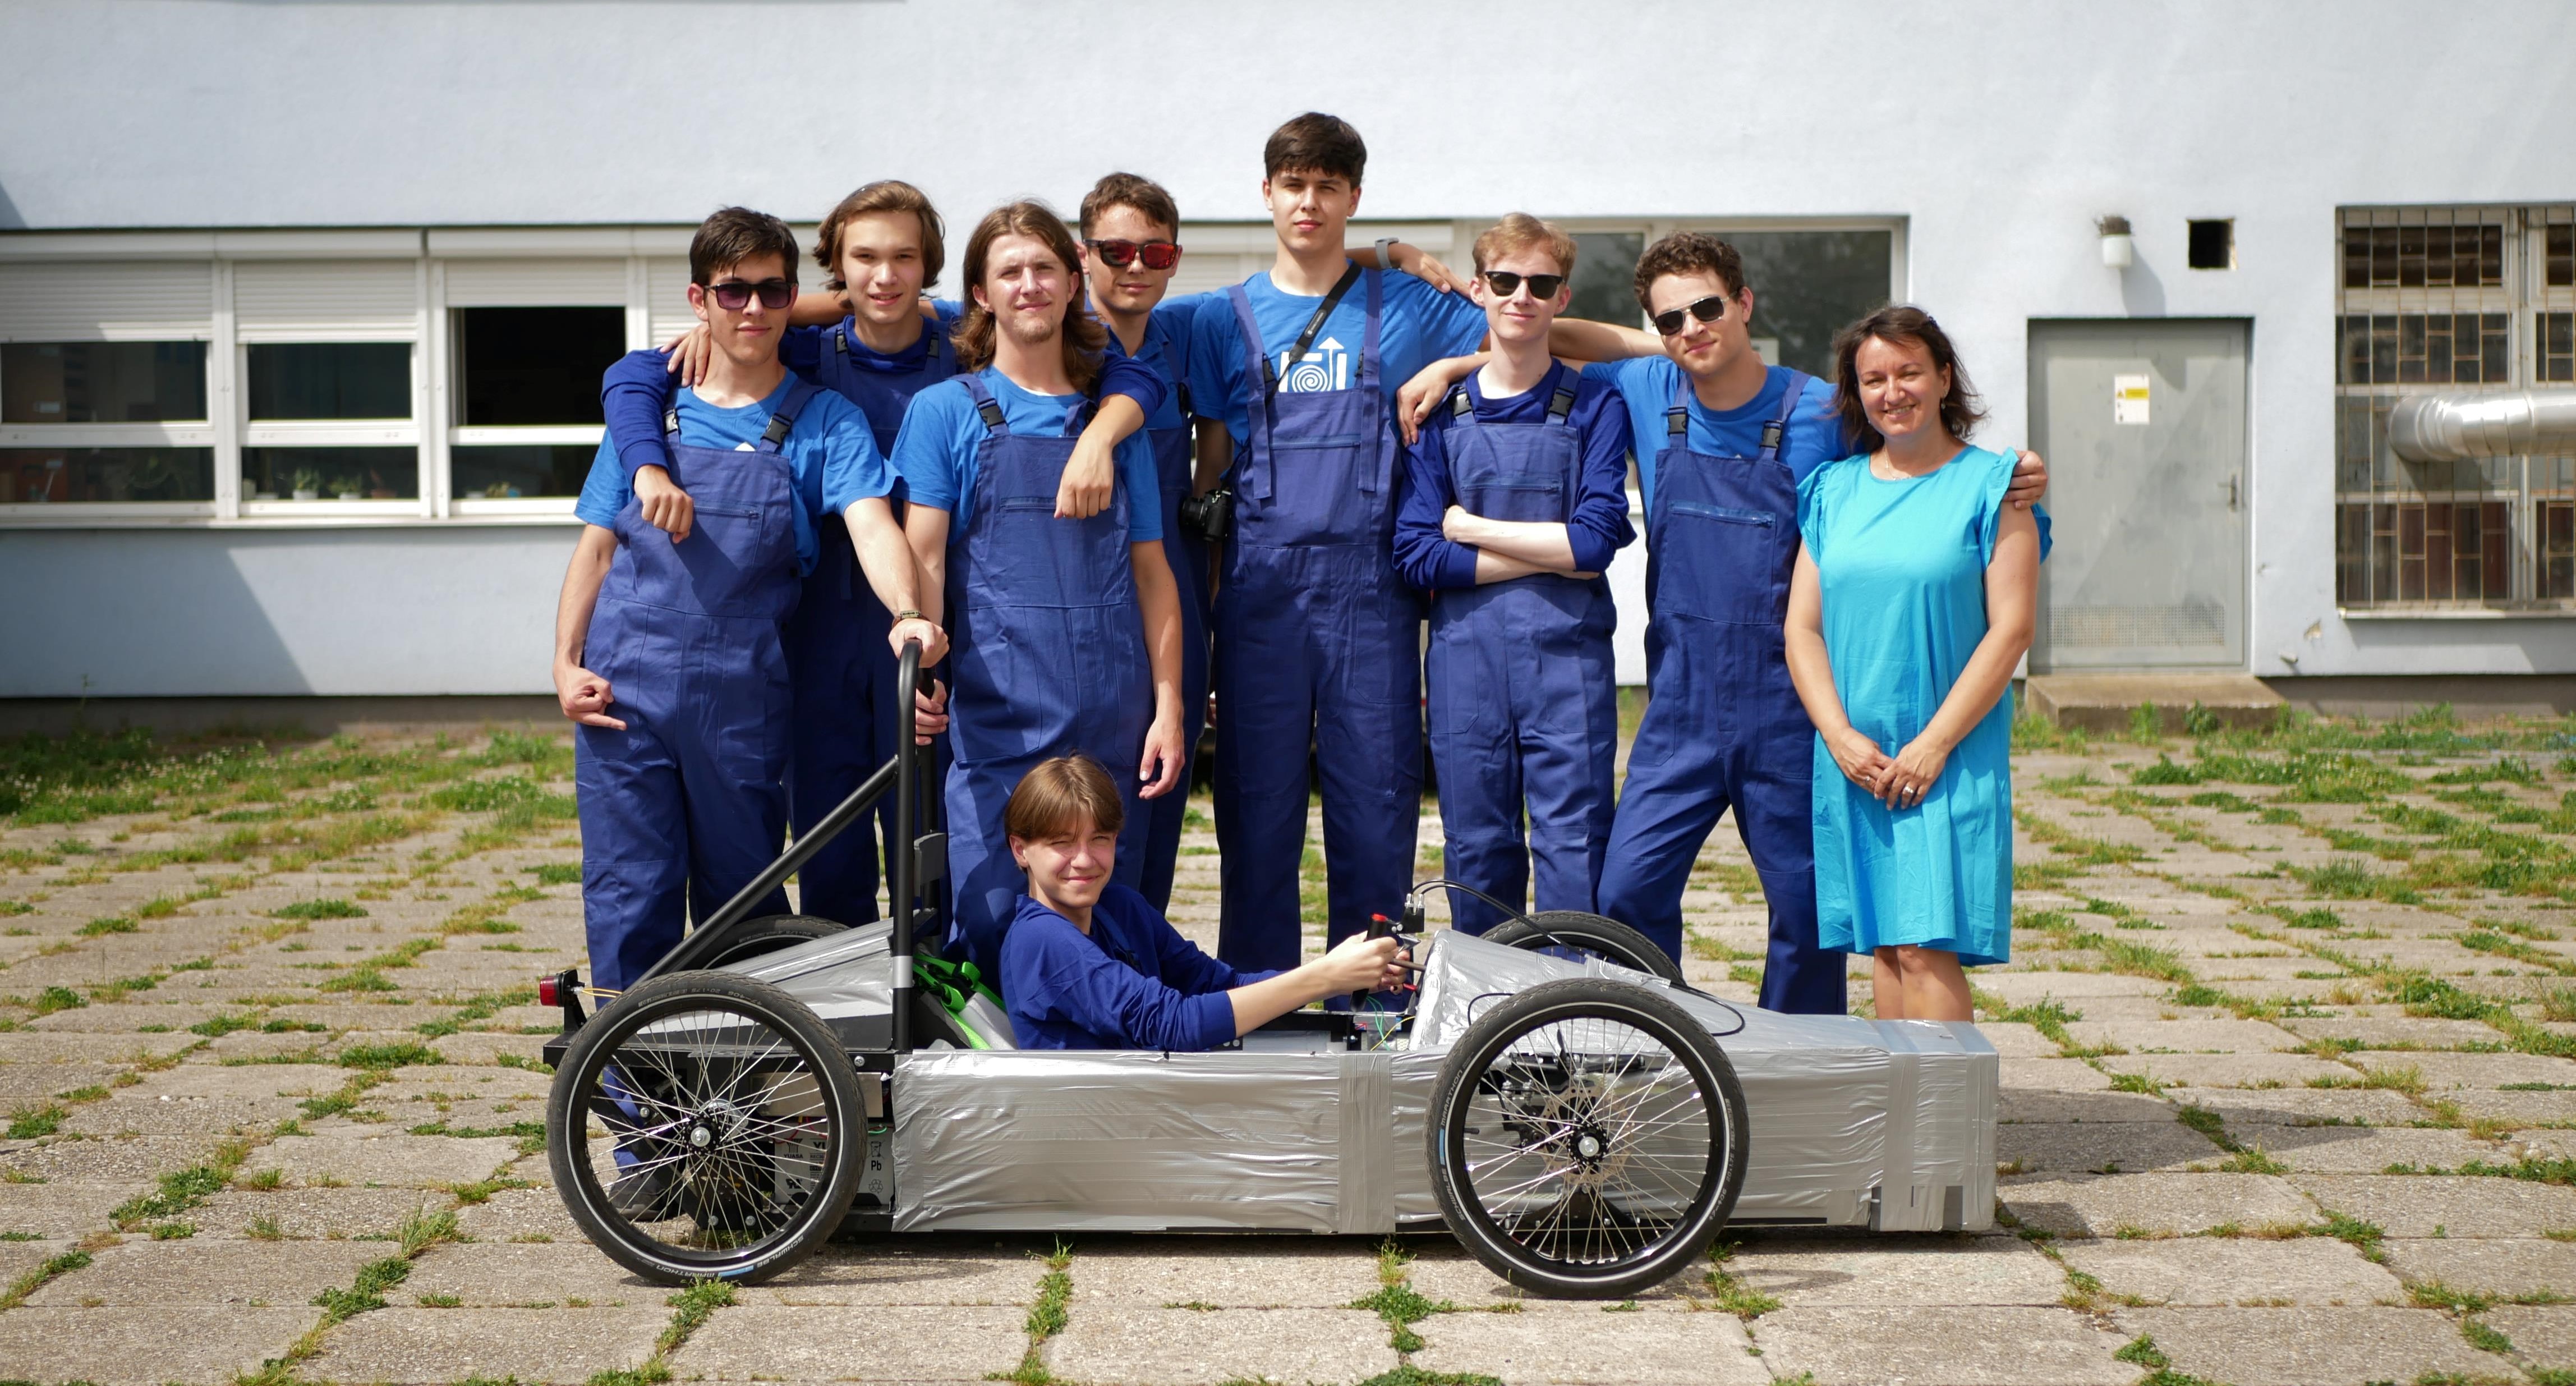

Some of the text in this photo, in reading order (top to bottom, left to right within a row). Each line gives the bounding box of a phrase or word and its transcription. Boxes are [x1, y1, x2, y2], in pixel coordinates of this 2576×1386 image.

[1440, 1068, 1466, 1221] SCHWALBE MARATHON
[871, 1160, 882, 1171] Pb
[757, 1234, 804, 1268] SCHWALBE
[656, 1264, 715, 1278] MARATHON
